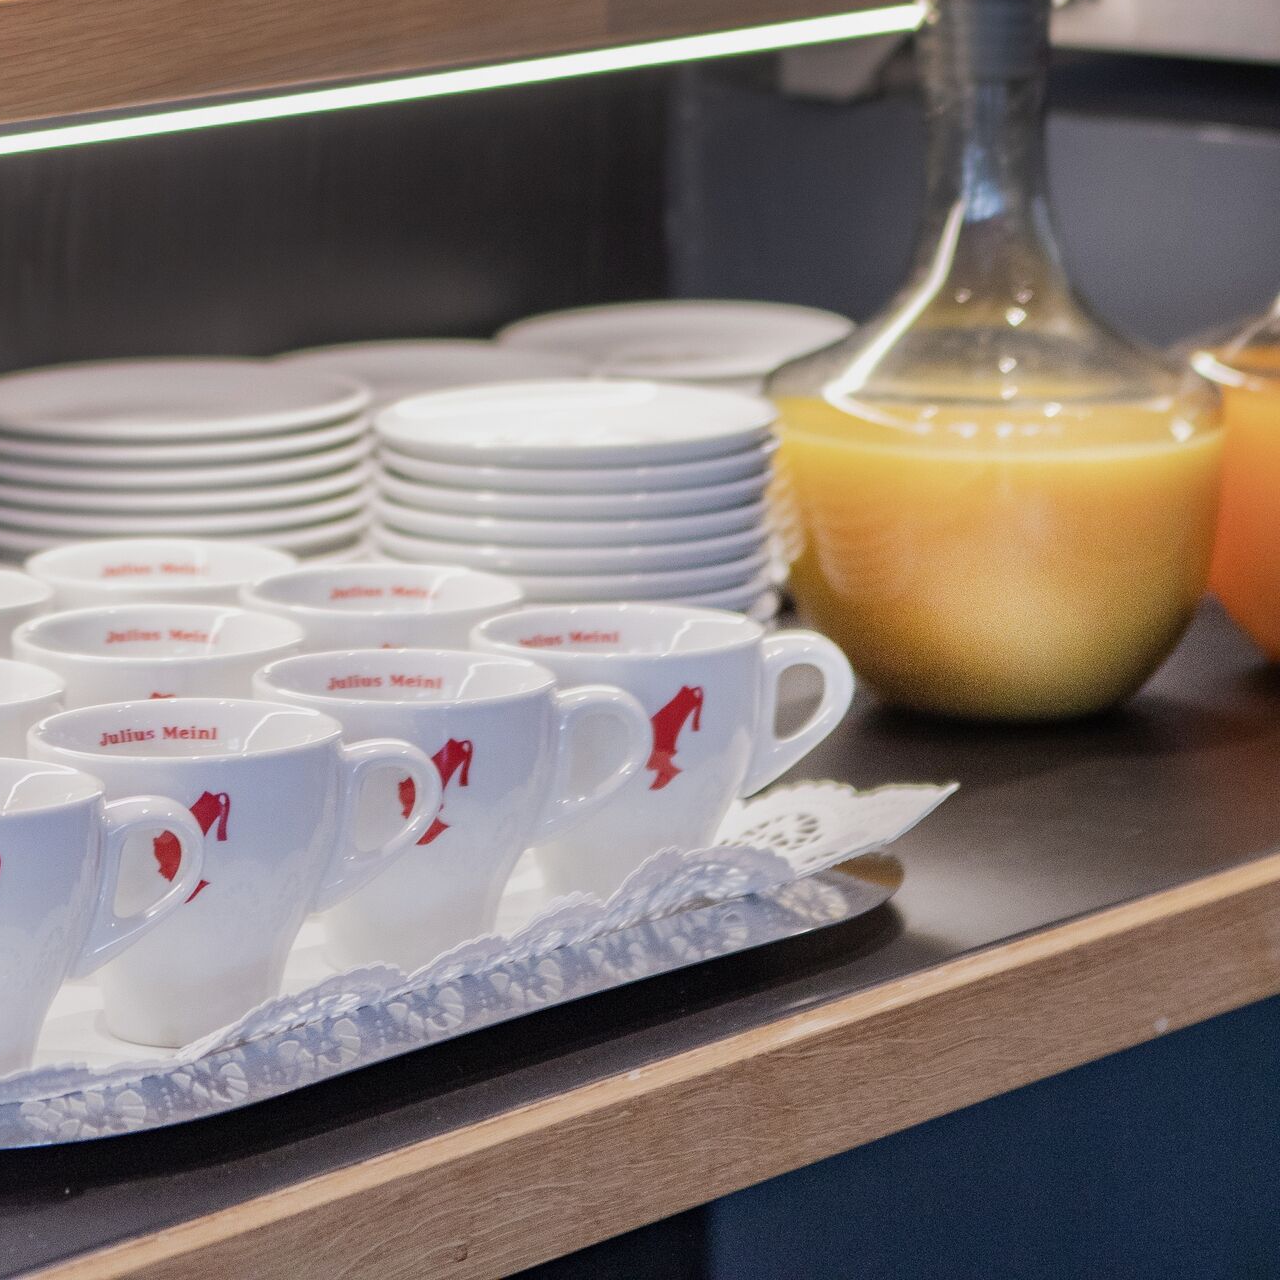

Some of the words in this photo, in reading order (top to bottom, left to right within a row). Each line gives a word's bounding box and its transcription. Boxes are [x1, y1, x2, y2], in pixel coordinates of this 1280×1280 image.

[327, 674, 383, 692] Julius
[389, 674, 443, 690] Meinl
[99, 728, 156, 747] Julius
[162, 725, 218, 742] Meinl
